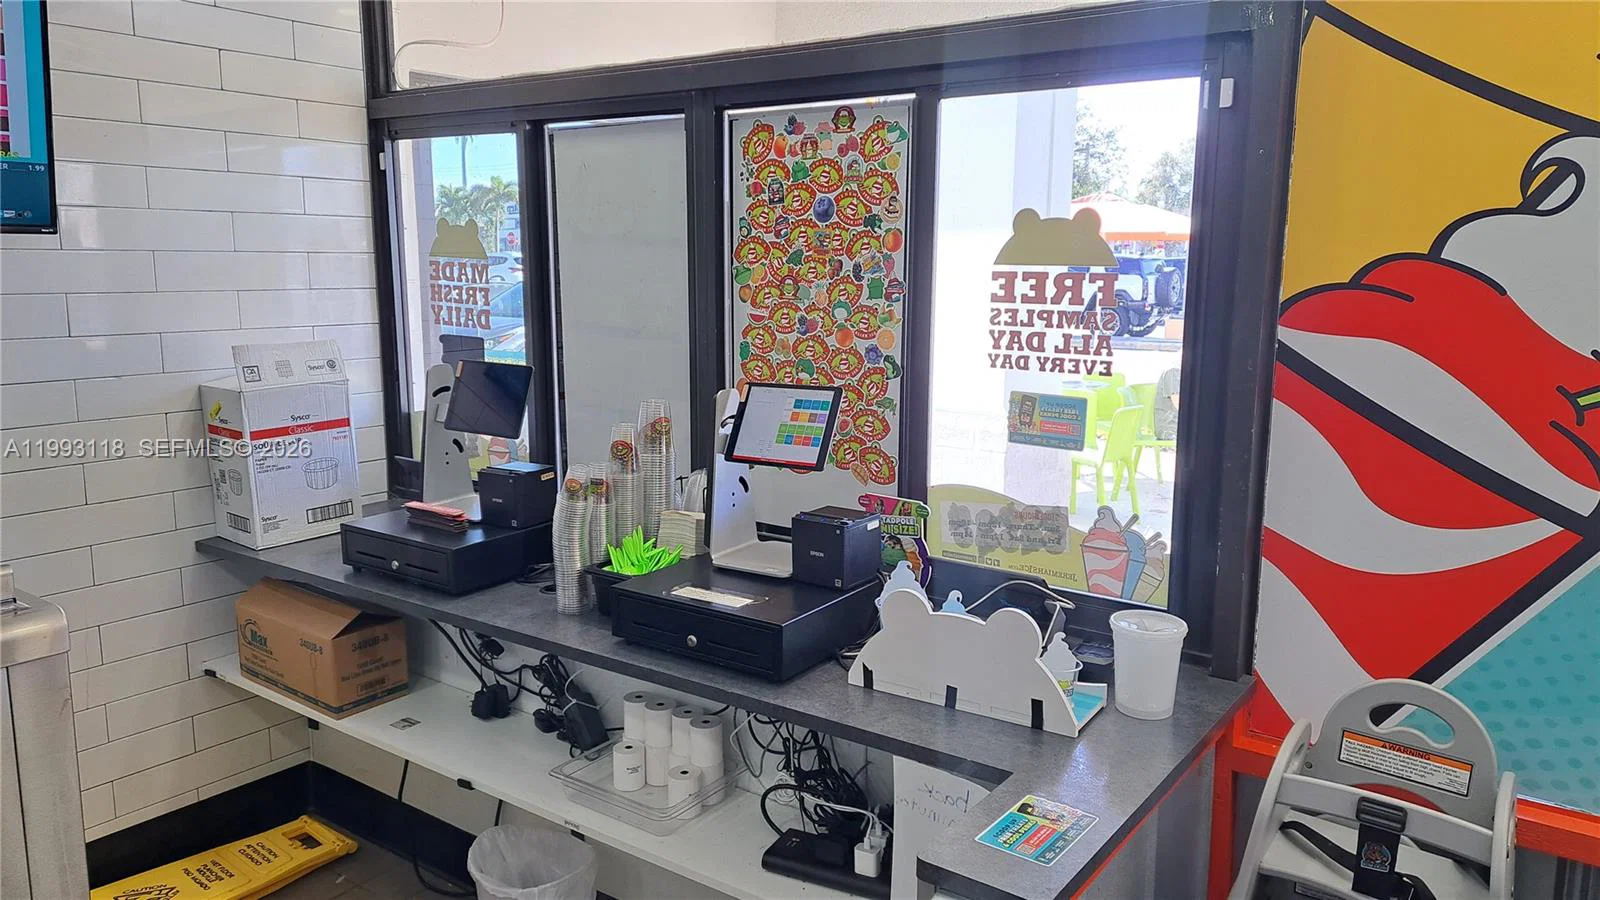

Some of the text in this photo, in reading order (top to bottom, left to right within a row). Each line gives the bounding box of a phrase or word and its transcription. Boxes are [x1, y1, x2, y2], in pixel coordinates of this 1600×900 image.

[288, 425, 314, 435] Classic
[882, 517, 915, 525] TADPOLE
[809, 550, 825, 558] EPSON
[1387, 744, 1431, 761] WARNING
[238, 849, 262, 866] CUIDADO
[245, 844, 273, 864] ATTENTION
[256, 841, 280, 860] CAUTION
[122, 884, 168, 895] CAUTION
